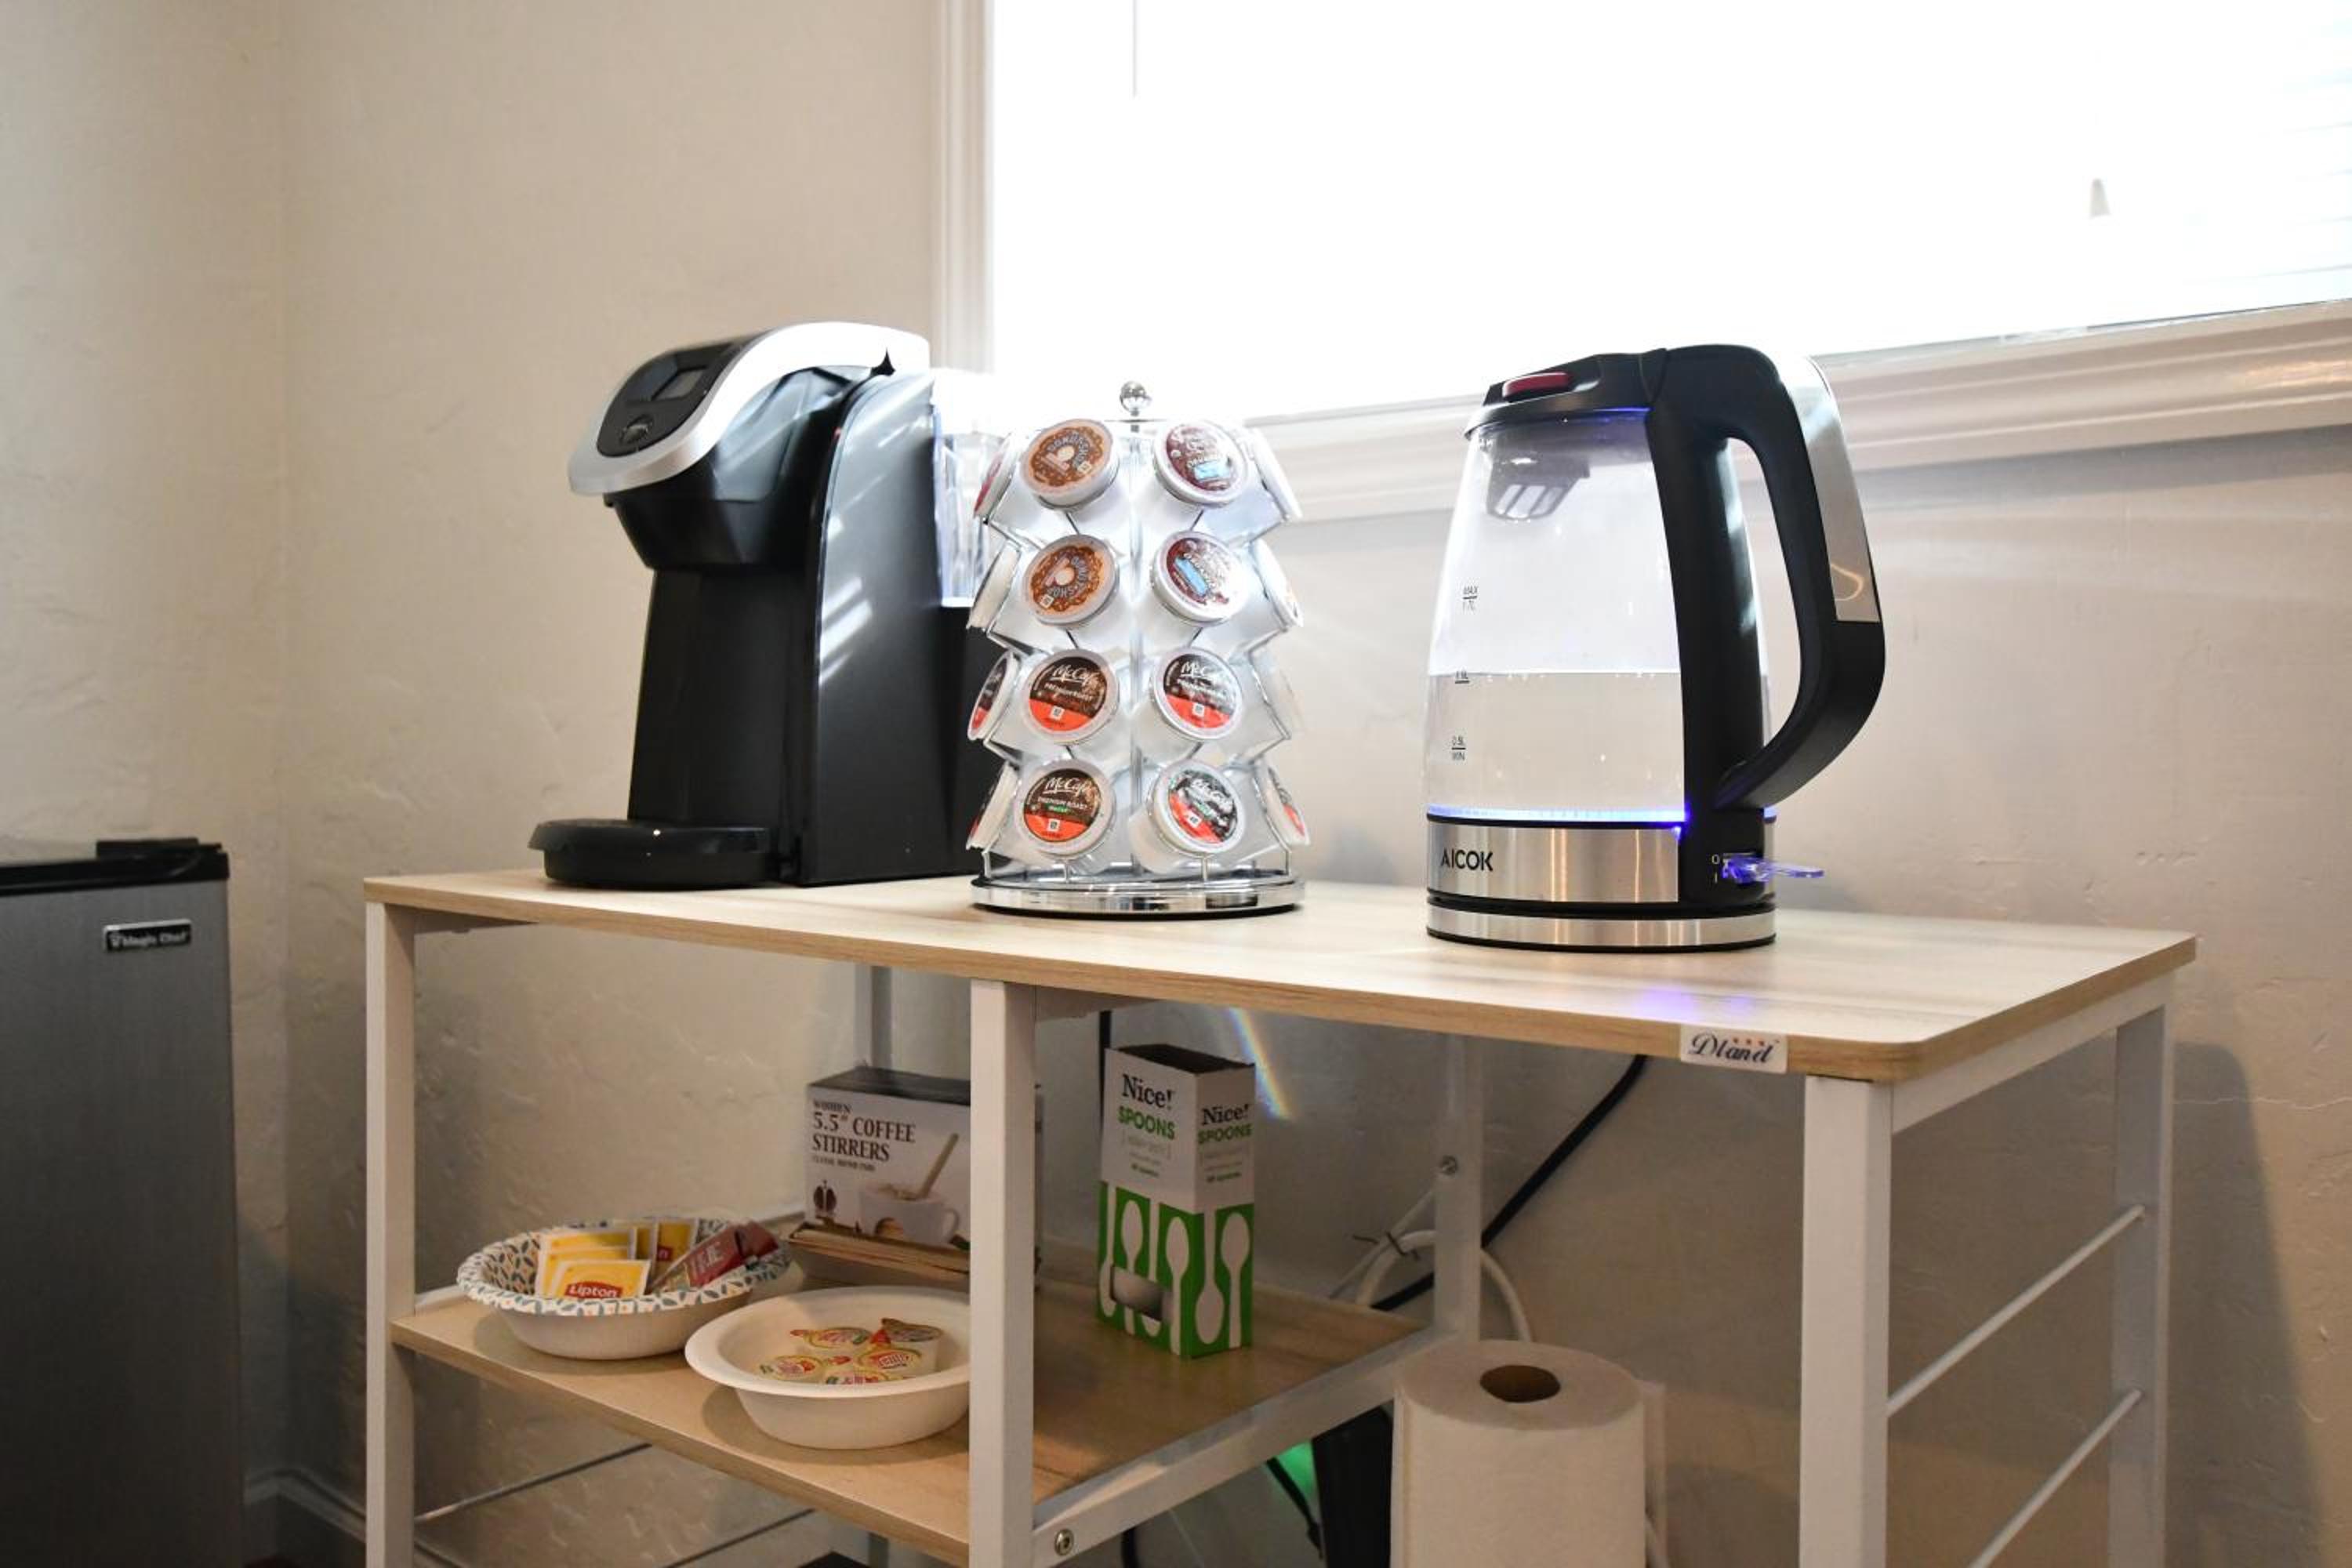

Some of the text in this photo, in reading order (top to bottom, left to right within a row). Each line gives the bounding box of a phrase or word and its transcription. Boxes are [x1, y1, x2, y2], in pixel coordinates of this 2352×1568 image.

[1179, 661, 1225, 685] McC
[1440, 848, 1494, 872] AICOK
[1122, 1073, 1174, 1110] Nice!
[1118, 1105, 1175, 1141] SPOONS
[1201, 1103, 1250, 1126] Nice!
[853, 1116, 916, 1144] COFFEE
[812, 1132, 890, 1162] STIRRERS
[569, 1283, 618, 1298] Lipton
